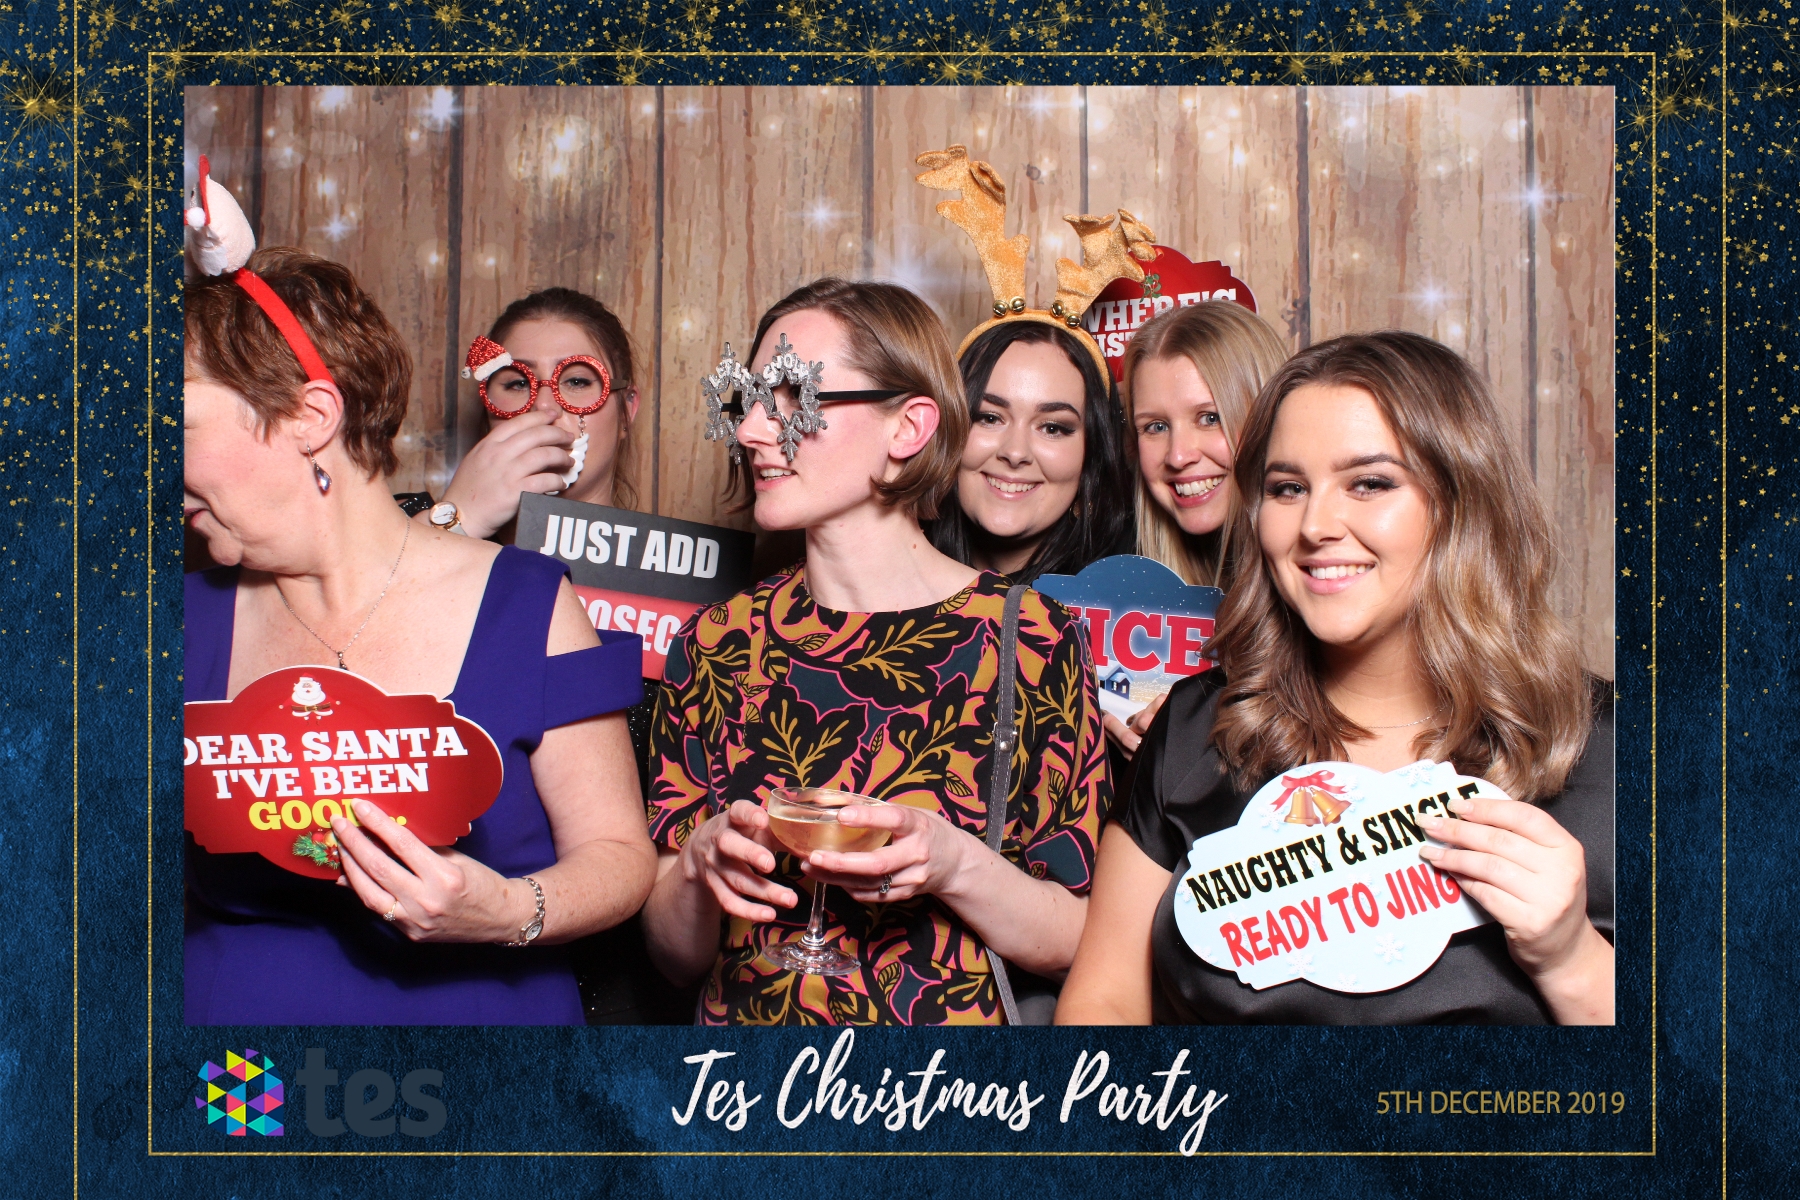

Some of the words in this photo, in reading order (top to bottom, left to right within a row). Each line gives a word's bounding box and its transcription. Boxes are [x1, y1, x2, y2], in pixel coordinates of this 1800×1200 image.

[540, 514, 637, 567] JUST
[640, 529, 720, 579] ADD
[578, 595, 682, 655] OSEC
[1065, 605, 1215, 677] ICE
[301, 726, 468, 762] SANTA
[212, 767, 302, 799] I'VE
[310, 763, 429, 795] BEEN
[1186, 834, 1334, 913] NAUGHTY
[1337, 826, 1367, 865] &
[1219, 896, 1329, 967] READY
[1327, 882, 1380, 934] TO
